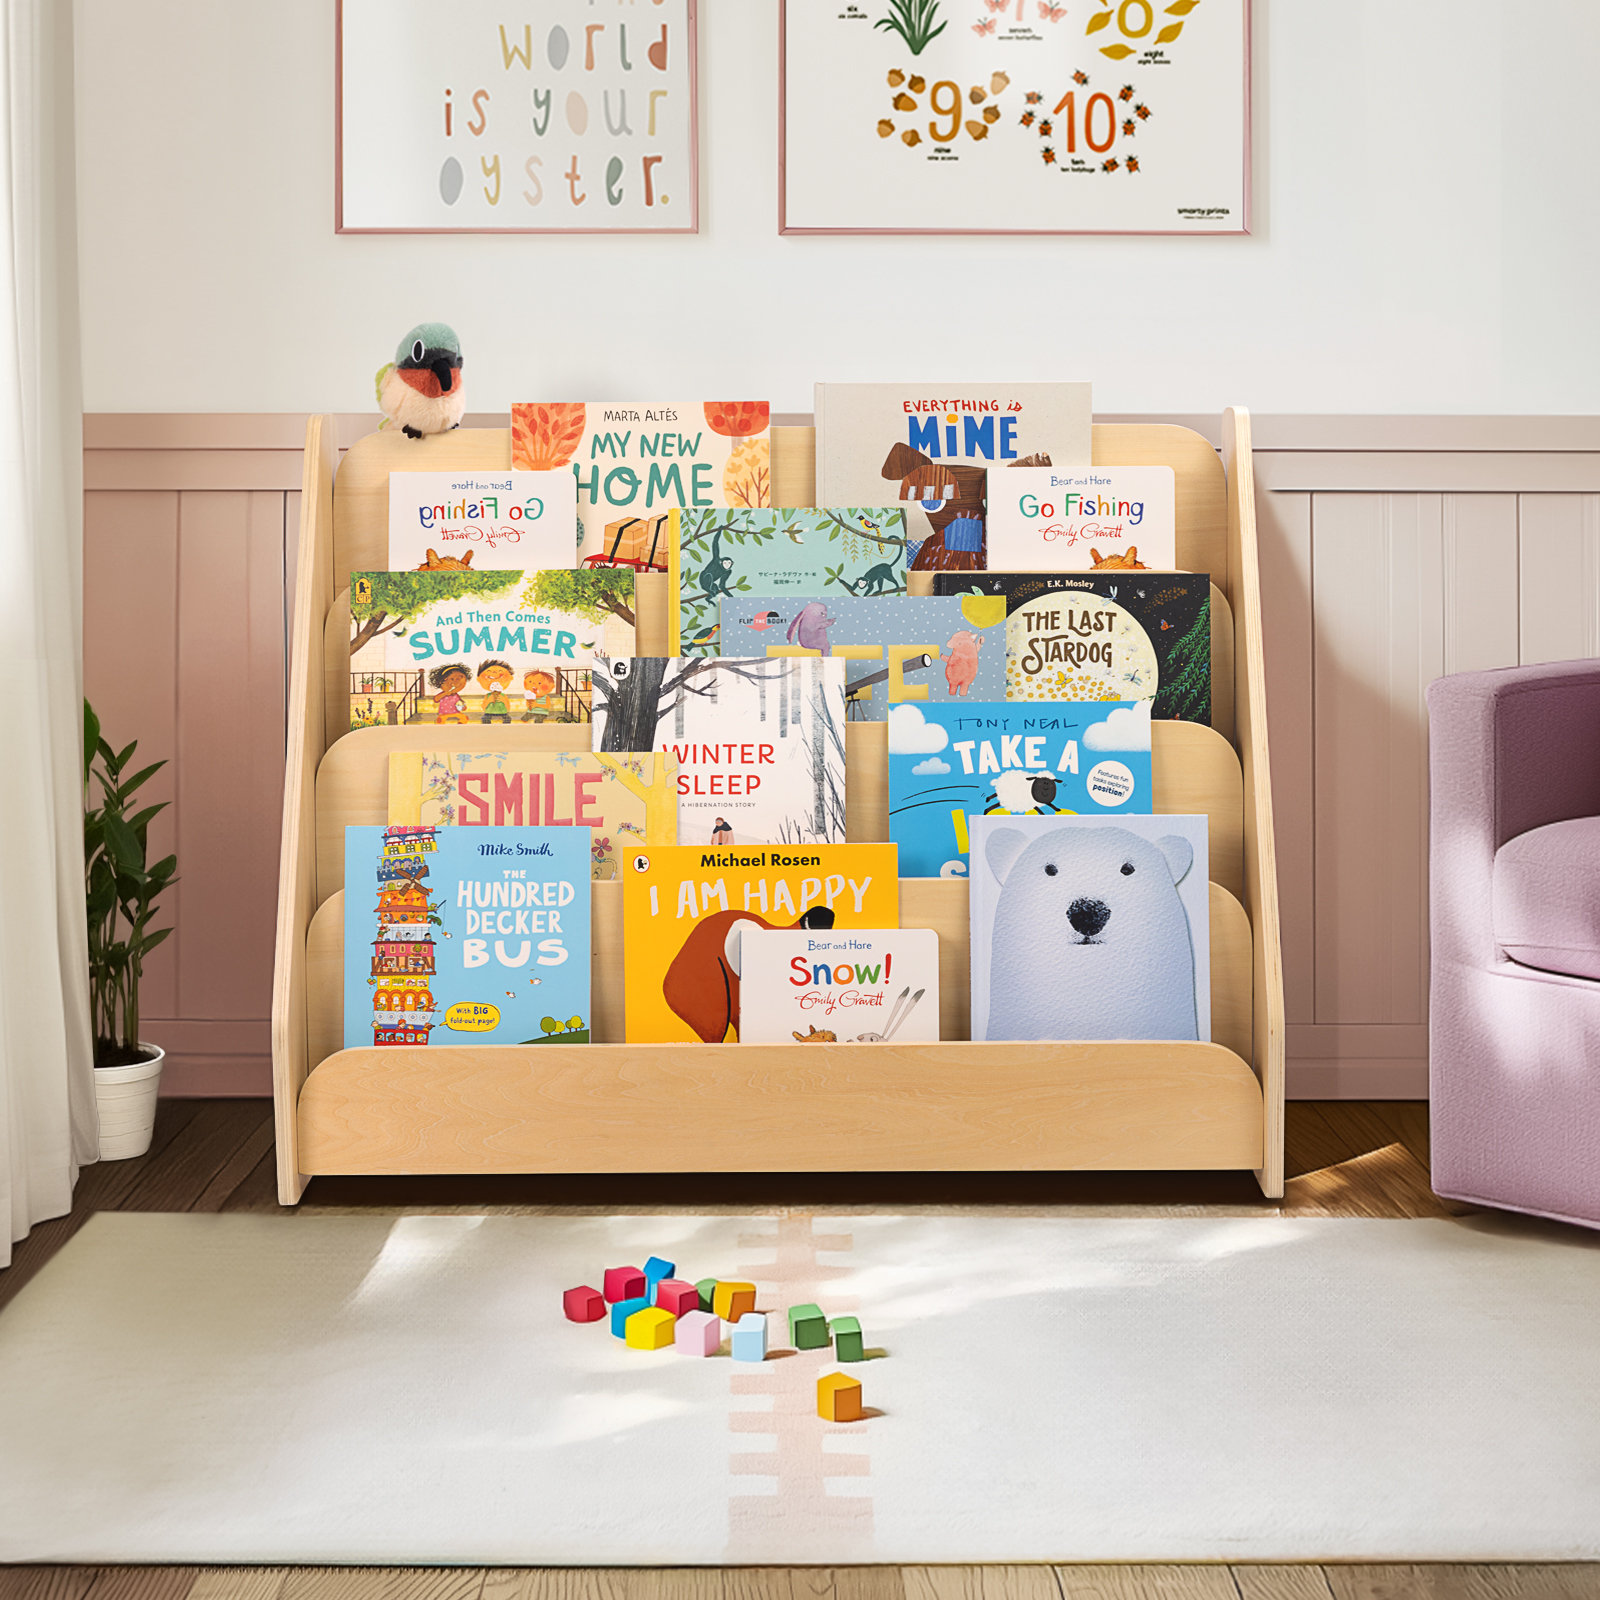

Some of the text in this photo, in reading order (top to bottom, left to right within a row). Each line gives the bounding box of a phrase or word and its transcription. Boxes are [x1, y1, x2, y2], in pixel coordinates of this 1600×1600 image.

[445, 88, 668, 136] is your
[929, 80, 962, 142] 9
[1053, 91, 1116, 153] 10
[439, 155, 669, 206] oyster.
[603, 407, 678, 422] MARTA ALTÉS
[903, 399, 1023, 413] EVERYTHING is
[591, 430, 702, 460] MY NEW
[573, 462, 713, 508] HOME
[1050, 475, 1112, 487] Bear and Hare
[1019, 493, 1144, 525] Go Fishing
[1038, 522, 1123, 546] Emily Gravett
[1047, 579, 1094, 590] E.K. Mosley
[436, 610, 551, 627] And Then Comes
[1022, 609, 1117, 637] THE LAST
[409, 626, 577, 661] SUMMER
[1021, 634, 1112, 675] STARDOG
[954, 718, 1079, 731] TONY NEAL
[953, 734, 1079, 775] TAKE A
[677, 774, 761, 795] SLEEP
[1092, 784, 1126, 797] position!
[458, 772, 604, 827] SMILE
[477, 843, 554, 857] Mike Smith
[700, 852, 820, 868] Michael Rosen
[503, 870, 527, 879] THE
[457, 880, 575, 908] HUNDRED
[649, 874, 872, 918] I AM HAPPY
[466, 910, 563, 935] DECKER
[463, 938, 569, 968] BUS
[808, 940, 872, 951] Bear and Hare
[789, 953, 892, 987] Snow!
[473, 1006, 489, 1015] BIG
[794, 990, 885, 1015] Emily Gravett
